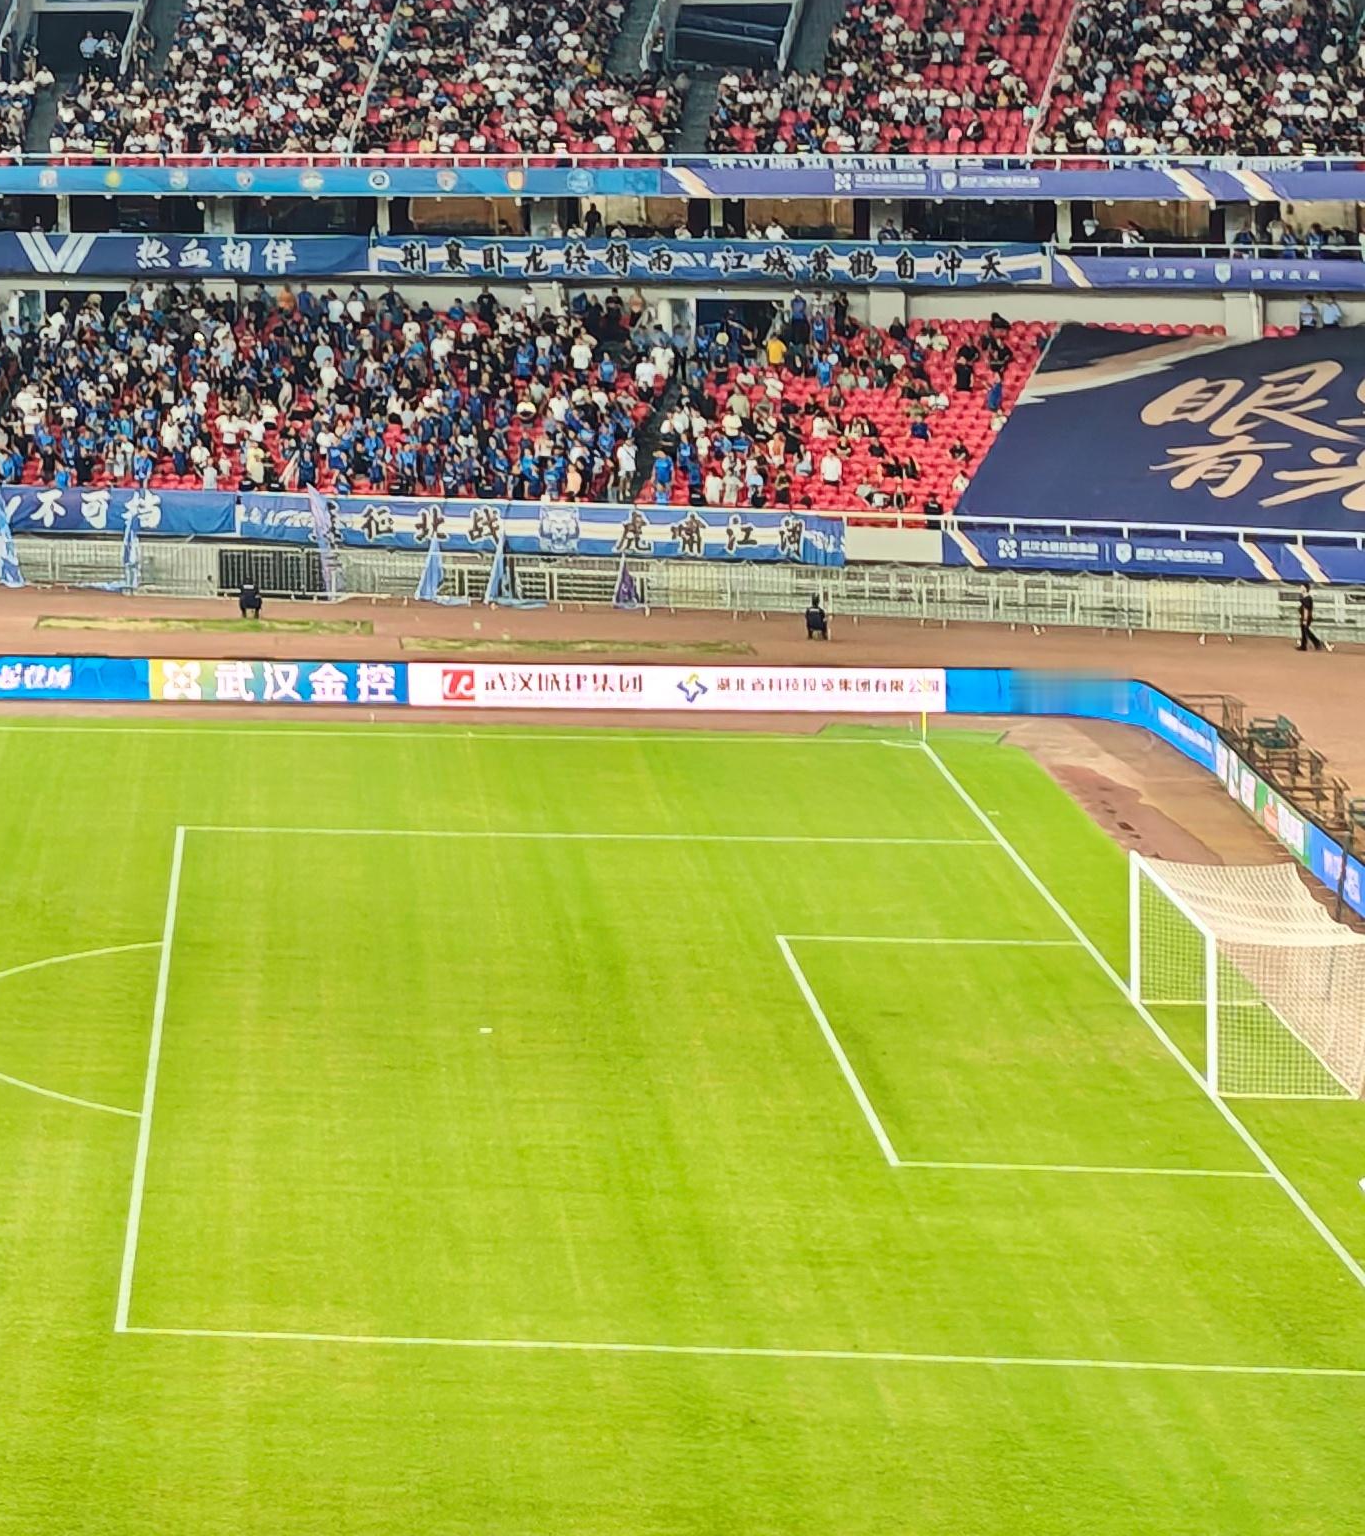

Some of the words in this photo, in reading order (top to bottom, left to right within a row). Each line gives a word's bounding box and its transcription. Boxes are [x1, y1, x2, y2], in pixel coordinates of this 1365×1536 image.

[136, 236, 297, 274] 热血相伴
[1140, 360, 1365, 448] 眼
[4, 487, 162, 530] 不可挡
[214, 662, 398, 702] 武汉金控
[484, 670, 643, 693] 武汉城建集团
